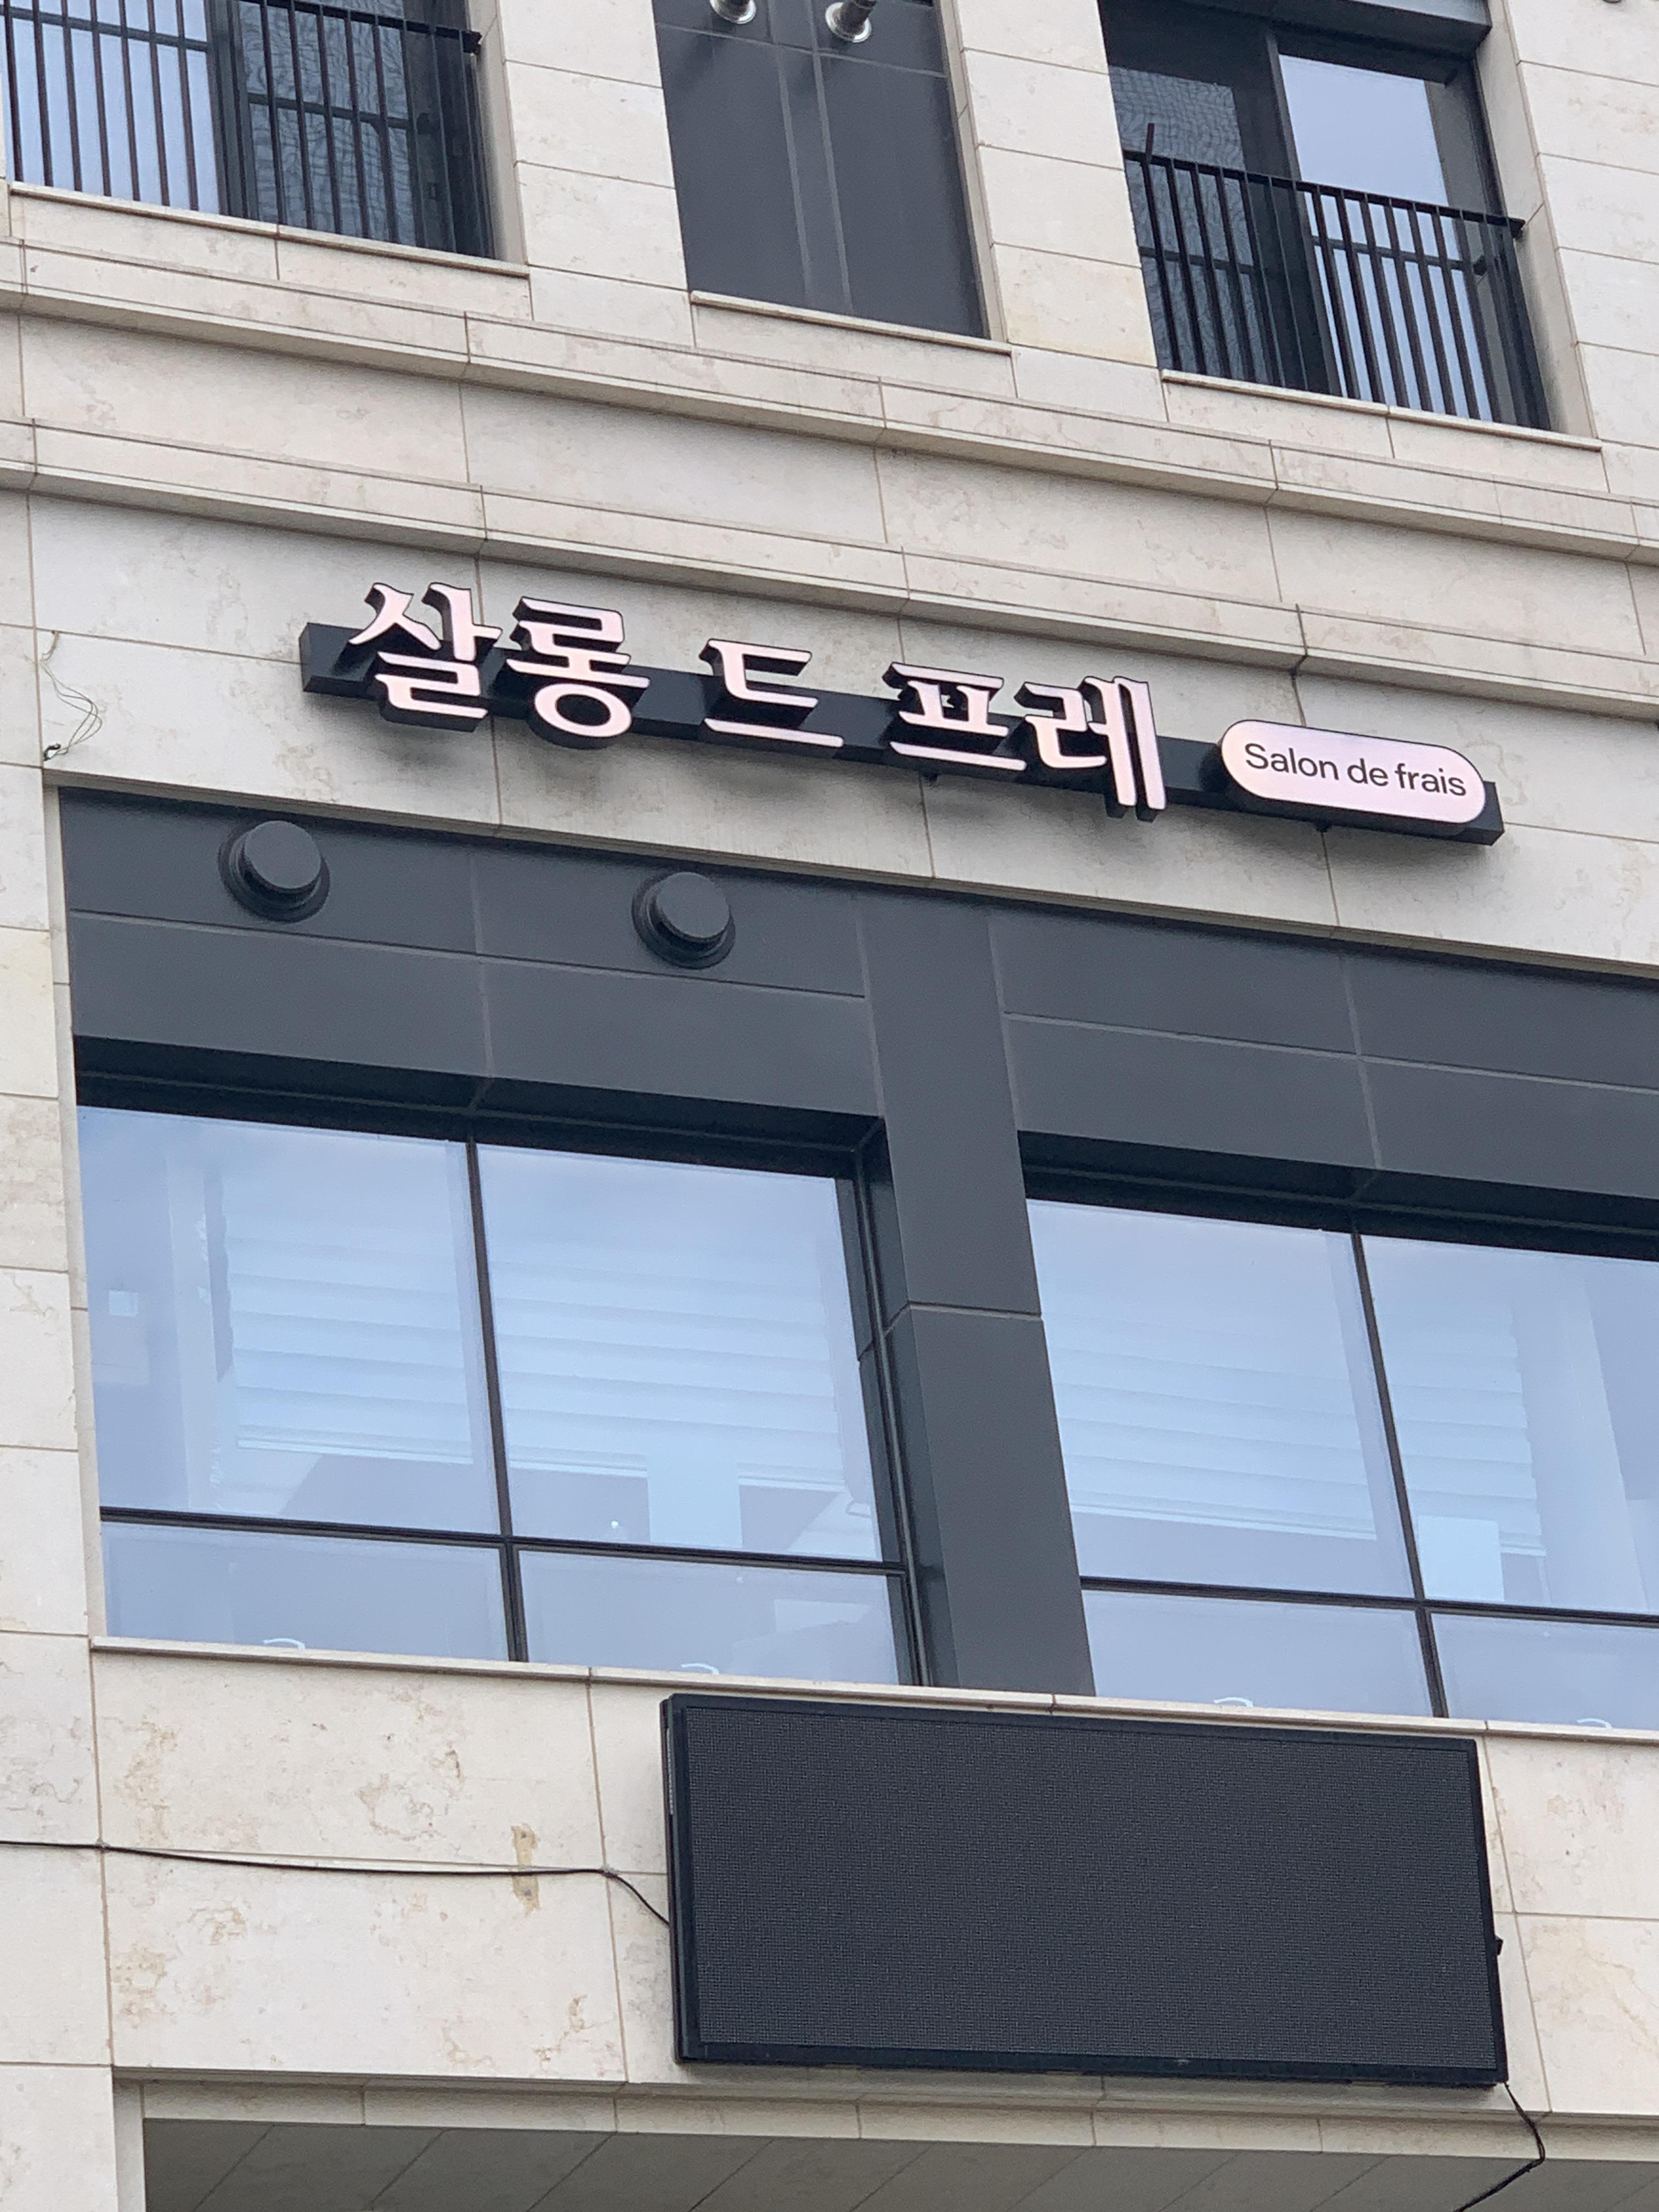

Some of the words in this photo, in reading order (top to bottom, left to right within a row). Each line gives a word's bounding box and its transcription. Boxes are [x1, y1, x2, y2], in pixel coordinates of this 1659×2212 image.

[348, 582, 651, 738] 살롱
[704, 639, 844, 748] 드
[890, 662, 1166, 810] 프레
[1244, 742, 1340, 781] Salon
[1347, 758, 1389, 787] de
[1394, 763, 1467, 797] frais
